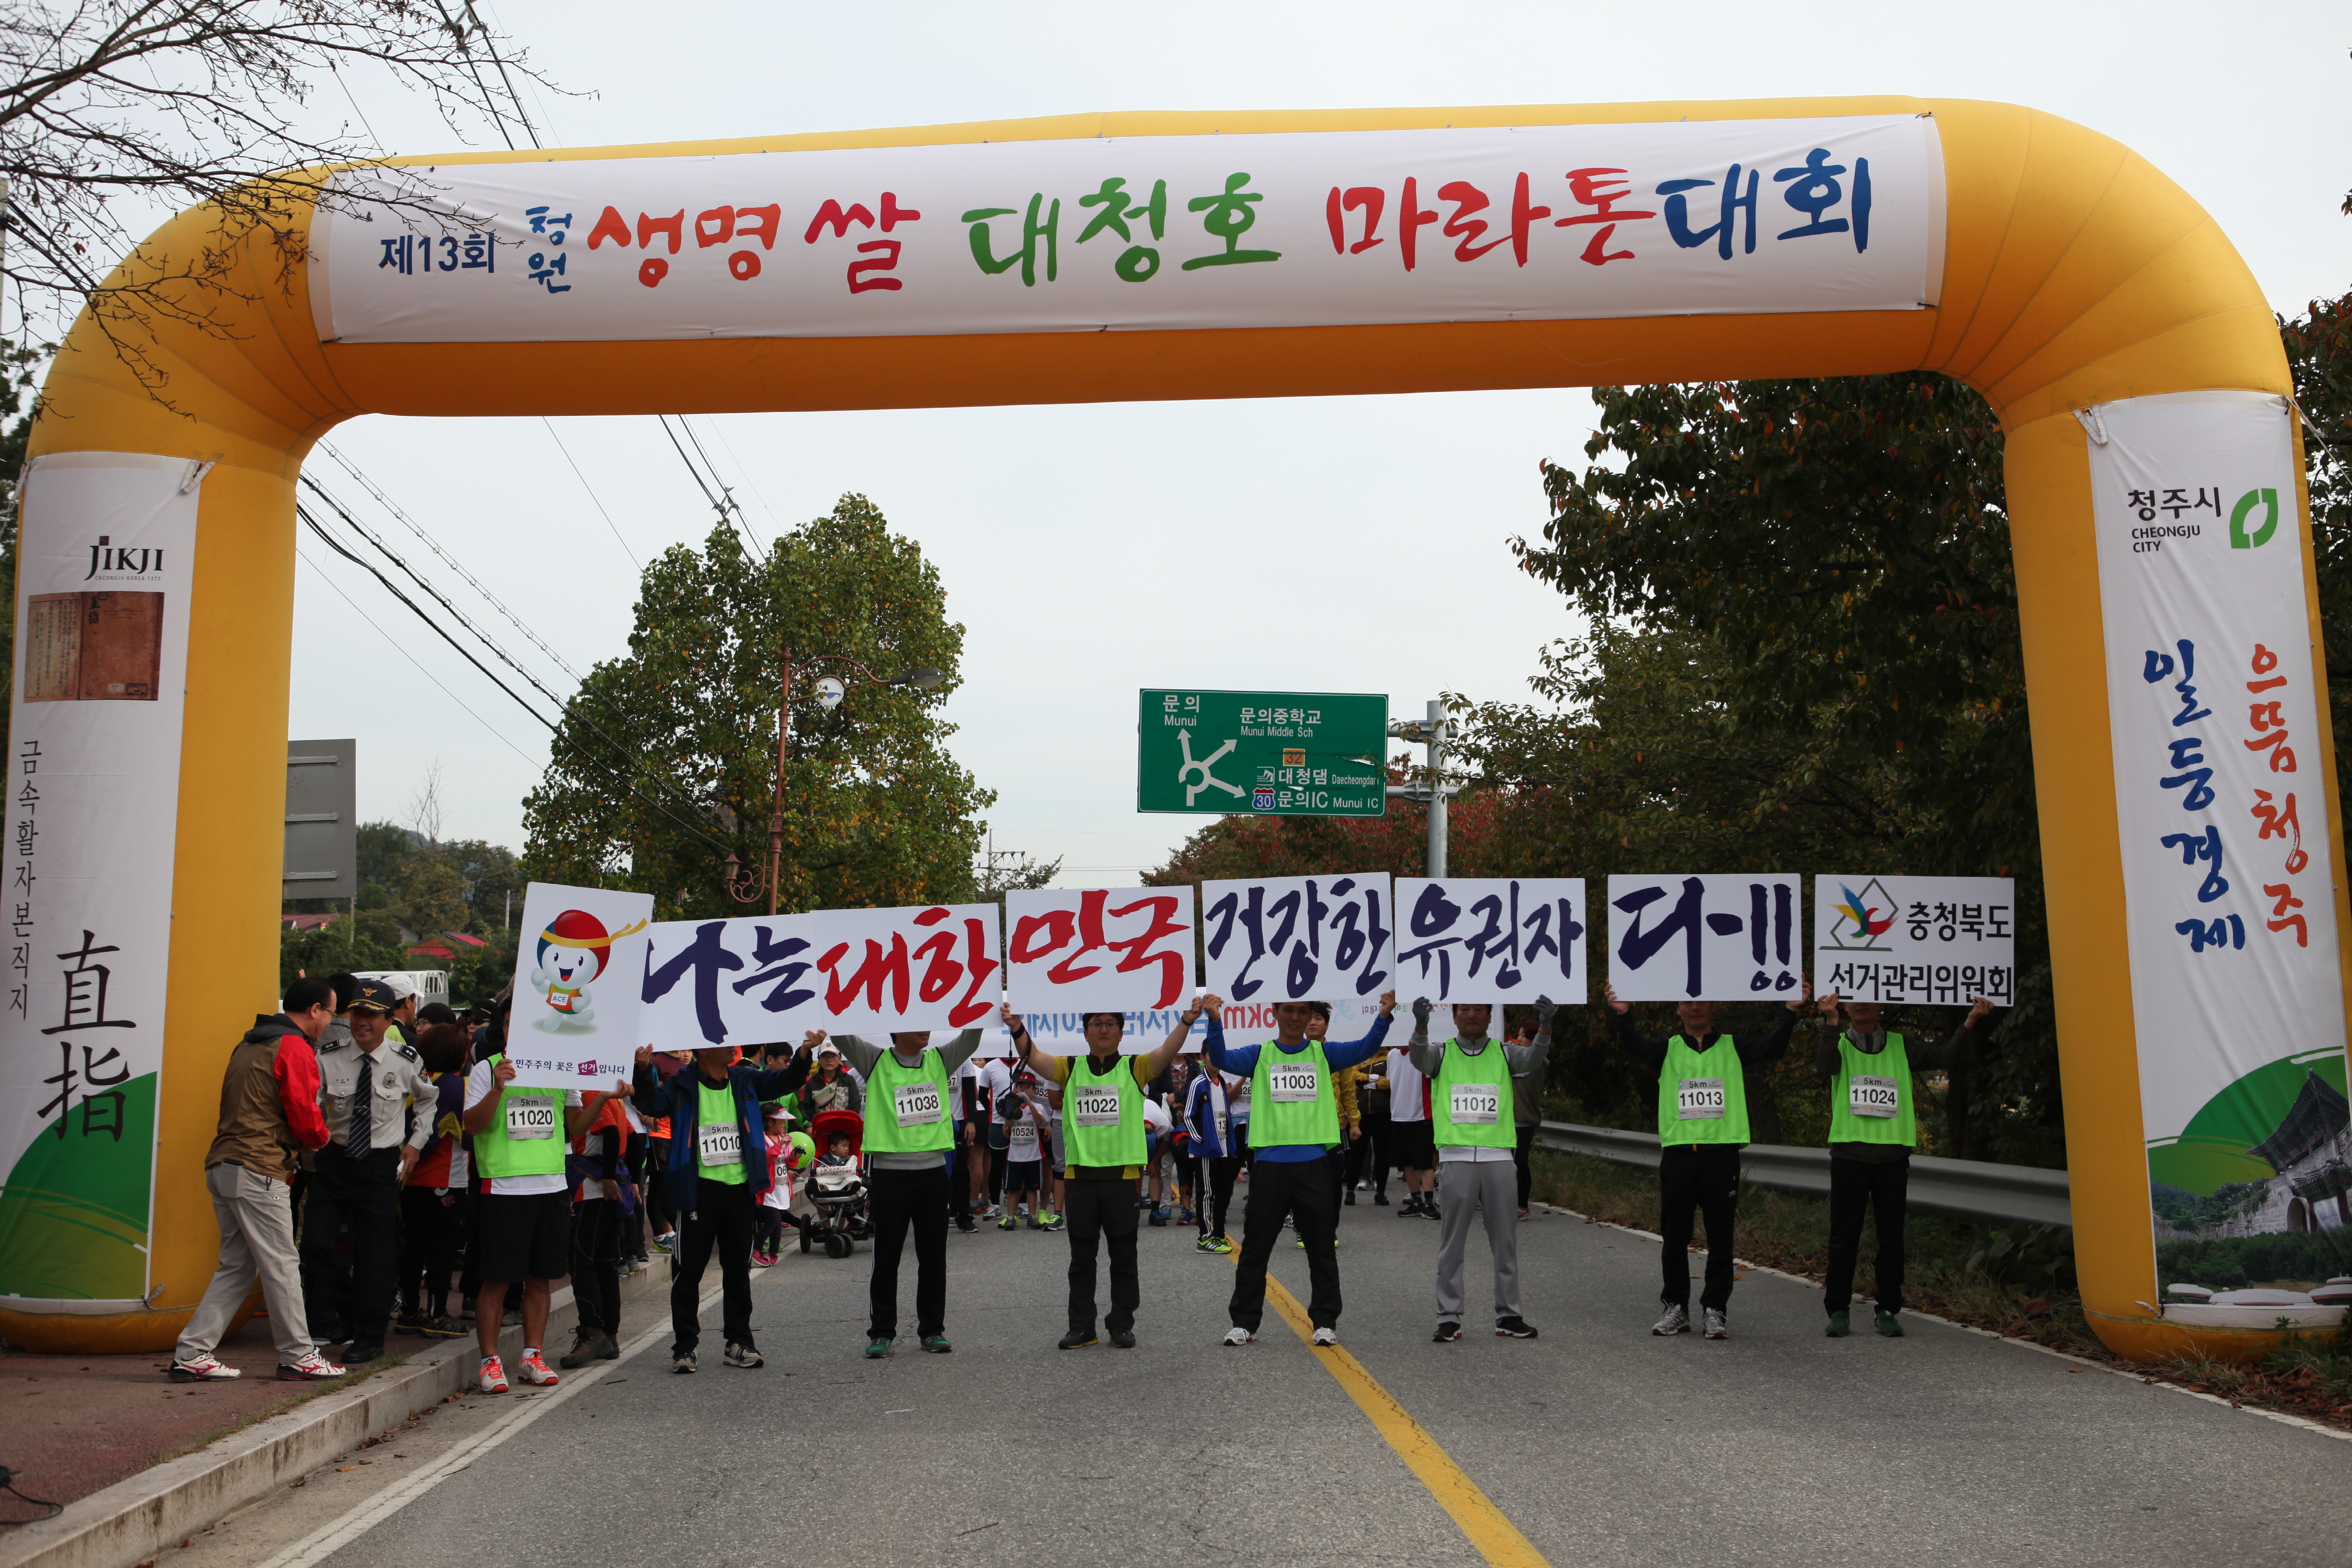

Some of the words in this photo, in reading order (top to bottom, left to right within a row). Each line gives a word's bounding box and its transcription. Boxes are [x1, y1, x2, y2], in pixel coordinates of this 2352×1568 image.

[378, 233, 496, 275] 제13회
[962, 172, 1282, 287] 대청호
[2128, 486, 2222, 522] 청주시
[2131, 525, 2201, 539] CHEONGJU
[2132, 540, 2162, 553] CITY
[84, 536, 165, 580] JIKJI
[1163, 695, 1200, 713] 문의
[1164, 715, 1197, 726] Munui
[1240, 707, 1322, 725] 문의중학교
[1241, 726, 1264, 736] Munui
[1267, 726, 1294, 737] Middle
[1297, 727, 1313, 738] Sch
[1286, 751, 1302, 764] 32
[1279, 768, 1327, 785] 대청댐
[1256, 795, 1271, 808] 30
[1333, 797, 1362, 808] Munui
[1368, 797, 1379, 808] IC
[1906, 902, 2012, 942] 충청북도
[641, 921, 816, 1045] 나는
[1205, 878, 1392, 1001] 건강한
[1396, 880, 1584, 1001] 유권자
[1828, 962, 2012, 1004] 선거관리위원회
[37, 929, 137, 1142] 直指
[516, 1059, 552, 1070] 민주주의
[556, 1061, 574, 1072] 꽃은
[1272, 1075, 1315, 1089] 11003
[898, 1095, 939, 1113] 11038
[1680, 1092, 1723, 1106] 11013
[1852, 1088, 1896, 1105] 11024
[1077, 1098, 1118, 1113] 11022
[1453, 1097, 1496, 1112] 11012
[509, 1110, 552, 1125] 11020
[1012, 1128, 1034, 1137] 10524
[702, 1135, 741, 1153] 11010
